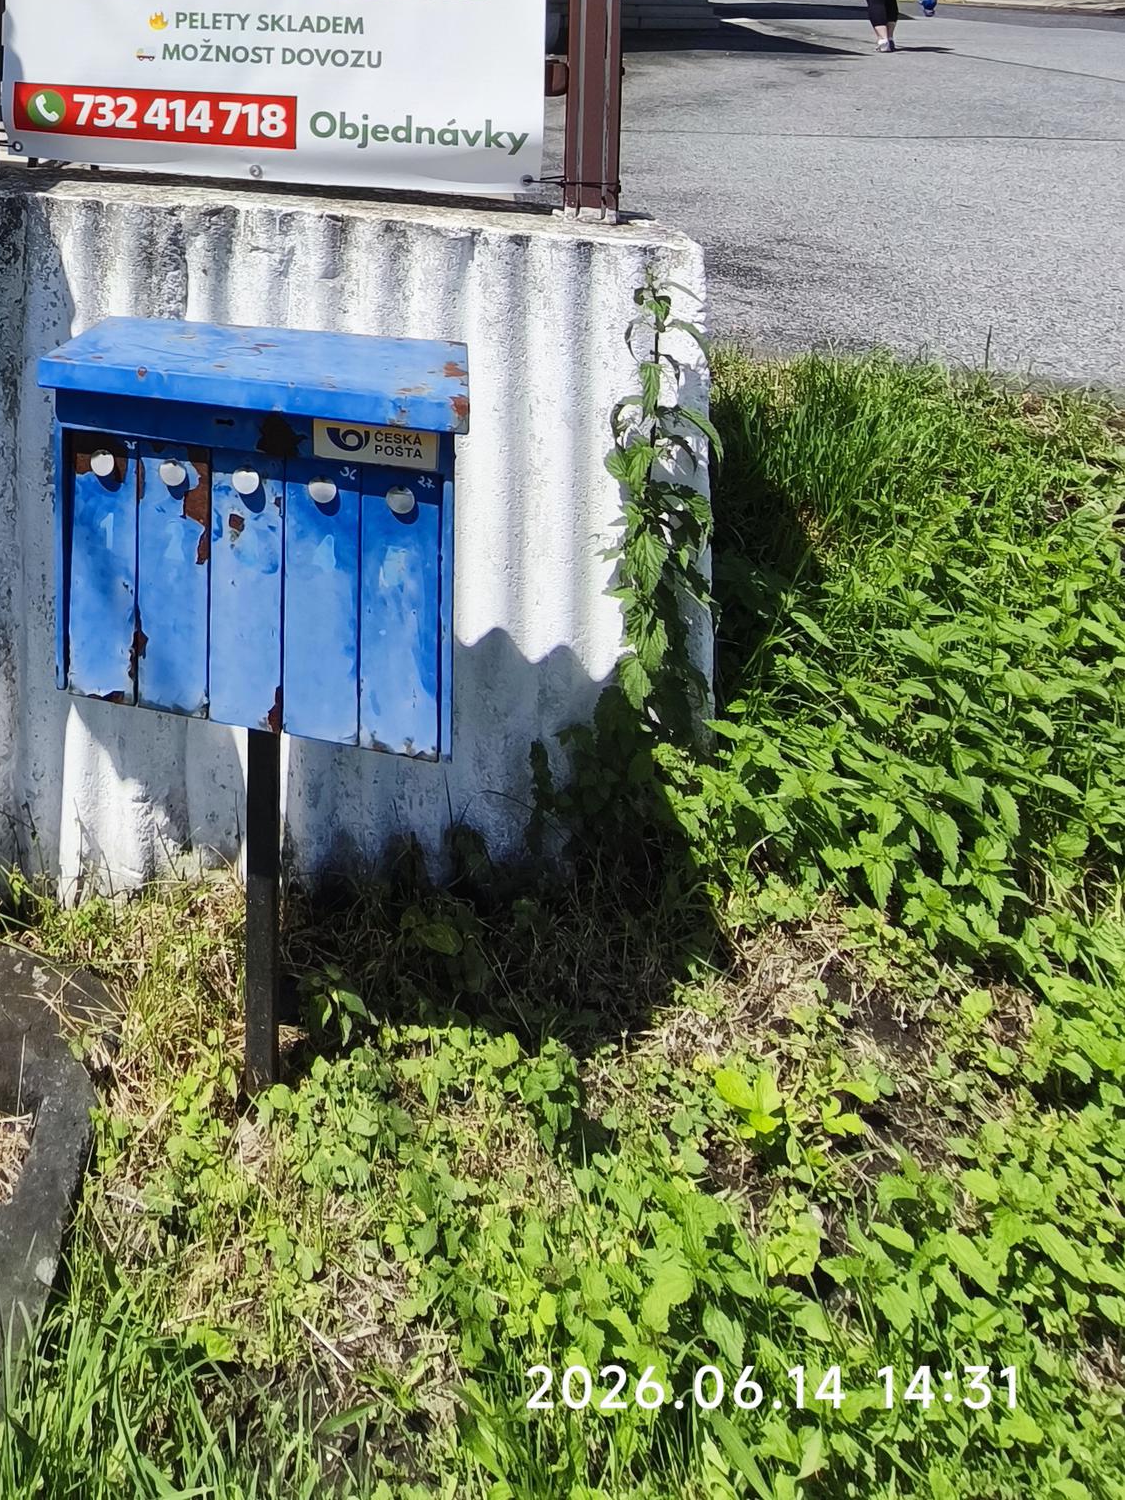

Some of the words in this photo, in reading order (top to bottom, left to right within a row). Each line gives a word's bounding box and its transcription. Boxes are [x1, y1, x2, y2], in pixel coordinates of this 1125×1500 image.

[175, 11, 250, 34] PELETY
[256, 13, 365, 36] SKLADEM
[162, 38, 275, 65] MOŽNOST
[280, 46, 383, 69] DOVOZU
[73, 93, 137, 131] 732
[143, 95, 213, 135] 414
[220, 100, 287, 138] 718
[309, 110, 529, 156] Objednávky
[374, 429, 423, 446] ČESKÁ
[374, 444, 423, 459] POŠTA
